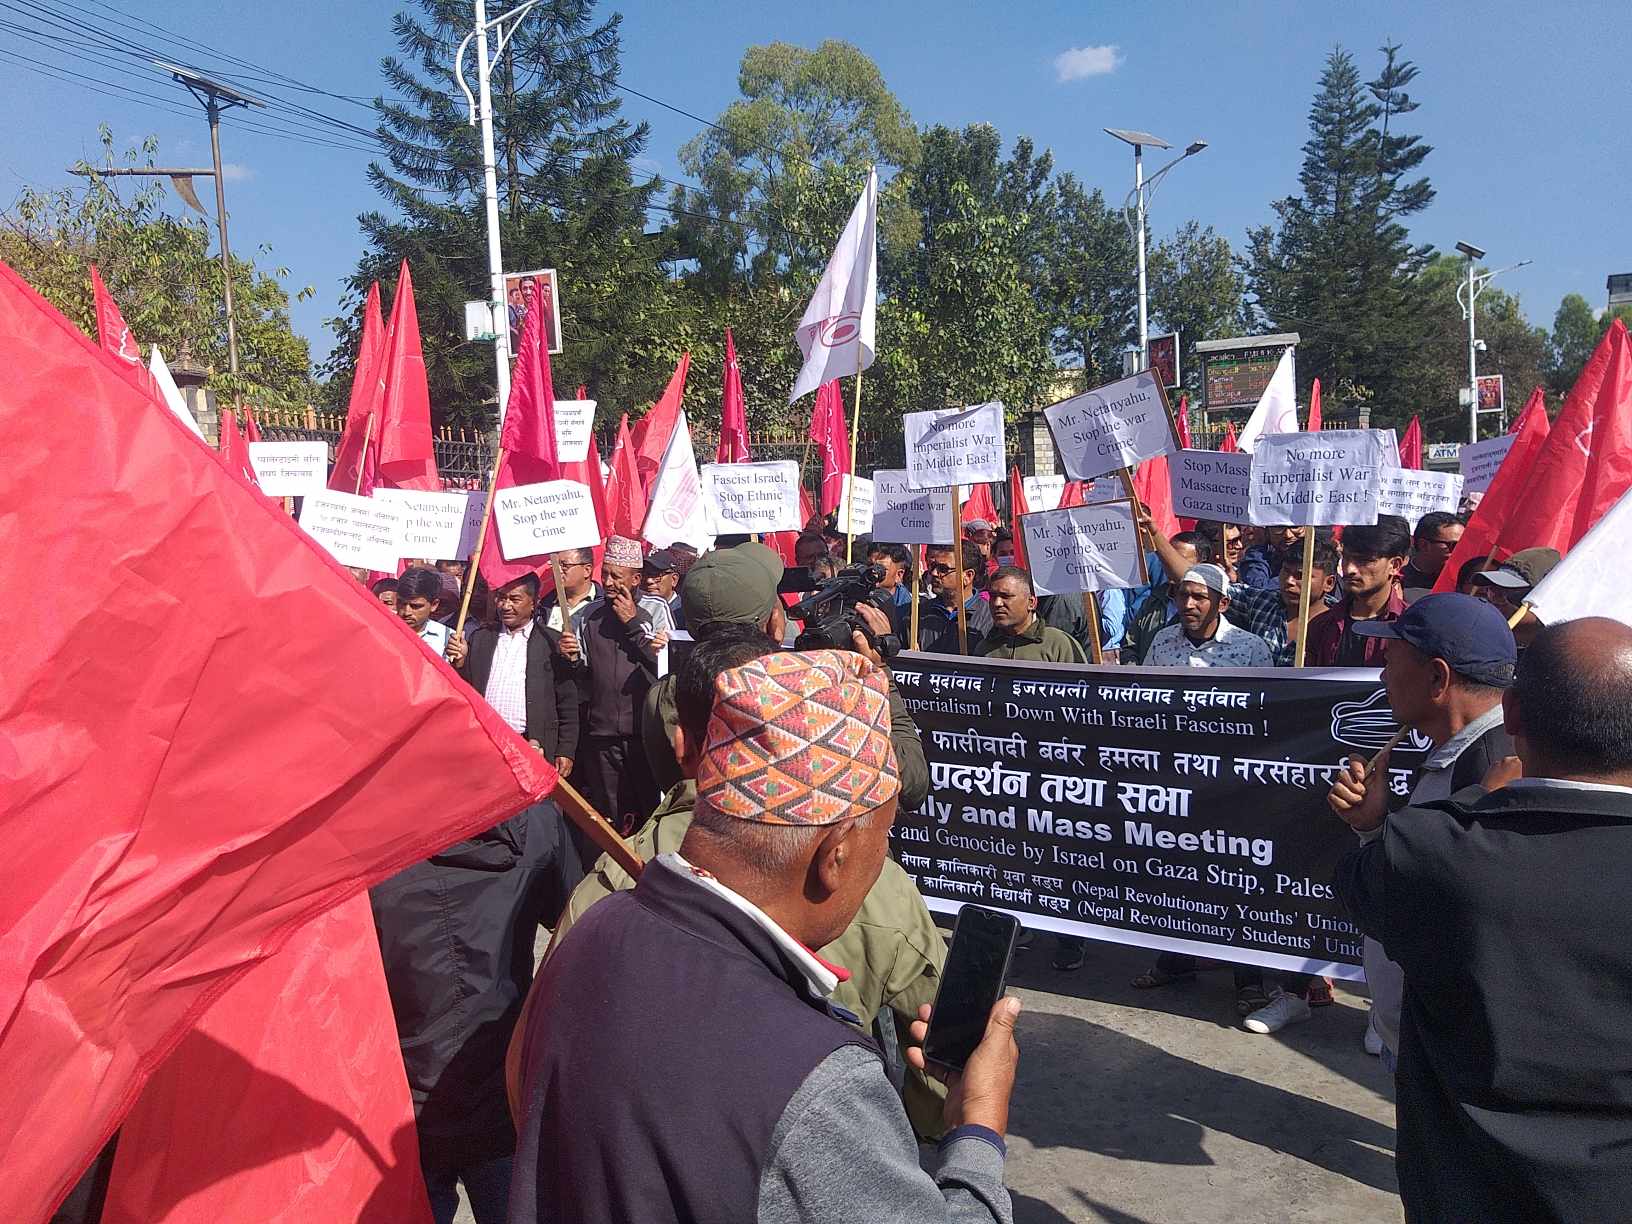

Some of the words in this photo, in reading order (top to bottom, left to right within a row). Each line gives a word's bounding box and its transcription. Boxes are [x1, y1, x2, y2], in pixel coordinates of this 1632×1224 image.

[1059, 415, 1080, 429] Mr.
[1080, 392, 1150, 421] Netanyahu,
[930, 421, 945, 433] No
[948, 419, 976, 431] more
[1073, 428, 1099, 445] Stop
[1102, 422, 1120, 434] the
[1123, 412, 1146, 427] war
[913, 437, 968, 454] Imperialist
[971, 434, 996, 446] War
[1097, 438, 1134, 456] Crime
[913, 459, 922, 471] in
[926, 455, 962, 470] Middle
[966, 452, 989, 465] East
[1286, 449, 1305, 461] No
[1310, 449, 1345, 460] more
[1433, 449, 1457, 458] ATM
[1184, 458, 1211, 475] Stop
[1216, 461, 1248, 476] Mass
[713, 473, 750, 484] Fascist
[754, 472, 788, 484] Israel,
[1263, 468, 1333, 486] Imperialist
[1339, 467, 1370, 481] War
[880, 482, 897, 494] Mr.
[1181, 477, 1237, 495] Massacre
[501, 498, 521, 510] Mr.
[524, 489, 584, 507] Netanyahu,
[720, 491, 744, 504] Stop
[746, 490, 783, 501] Ethnic
[1260, 493, 1271, 505] in
[1276, 490, 1323, 504] Middle
[1328, 490, 1359, 503] East
[722, 508, 775, 520] Cleansing
[887, 500, 907, 513] Stop
[910, 500, 925, 511] the
[928, 503, 946, 511] war
[1182, 496, 1213, 511] Gaza
[1216, 502, 1244, 518] strip
[417, 517, 432, 528] the
[434, 520, 454, 529] war
[513, 513, 538, 525] Stop
[540, 510, 556, 521] the
[559, 507, 580, 517] war
[901, 517, 930, 528] Crime
[404, 532, 438, 544] Crime
[532, 526, 566, 538] Crime
[1033, 527, 1054, 539] Mr.
[1057, 519, 1125, 537] Netanyahu,
[1045, 546, 1070, 559] Stop
[1073, 545, 1091, 555] the
[1095, 540, 1118, 552] war
[1066, 562, 1102, 575] Crime
[1012, 679, 1090, 702] इजरायली
[1097, 683, 1174, 706] फासीवाद
[902, 697, 982, 719] mperialism
[1004, 702, 1055, 722] Down
[1060, 706, 1104, 726] With
[1110, 710, 1167, 731] Israeli
[1174, 714, 1255, 737] Fascism
[931, 727, 1027, 758] फासीवादी
[1038, 736, 1087, 766] बर्बर
[1097, 746, 1161, 775] हमला
[1173, 752, 1220, 778] तथा
[929, 761, 1031, 799] प्रदर्शन
[1040, 773, 1107, 807] तथा
[1117, 782, 1192, 818] सभा
[962, 805, 1016, 829] and
[1027, 808, 1113, 843] Mass
[1123, 820, 1273, 867] Meeting
[901, 825, 930, 843] and
[935, 828, 1016, 857] Genocide
[1023, 842, 1045, 865] by
[1052, 845, 1104, 869] Israel
[1113, 858, 1138, 875] on
[1145, 857, 1199, 882] Gaza
[1206, 863, 1265, 896] Strip,
[1274, 873, 1335, 900] Pales
[901, 850, 931, 869] नेपाल
[936, 857, 997, 881] क्रान्तिकारी
[1003, 871, 1025, 888] युवा
[1072, 880, 1119, 902] (Nepal
[1124, 886, 1229, 920] Revolutionary
[1235, 903, 1298, 929] Youths'
[923, 873, 984, 898] क्रान्तिकारी
[1077, 900, 1124, 923] (Nepal
[1130, 908, 1236, 942] Revolutionary
[1242, 926, 1316, 951] Students'
